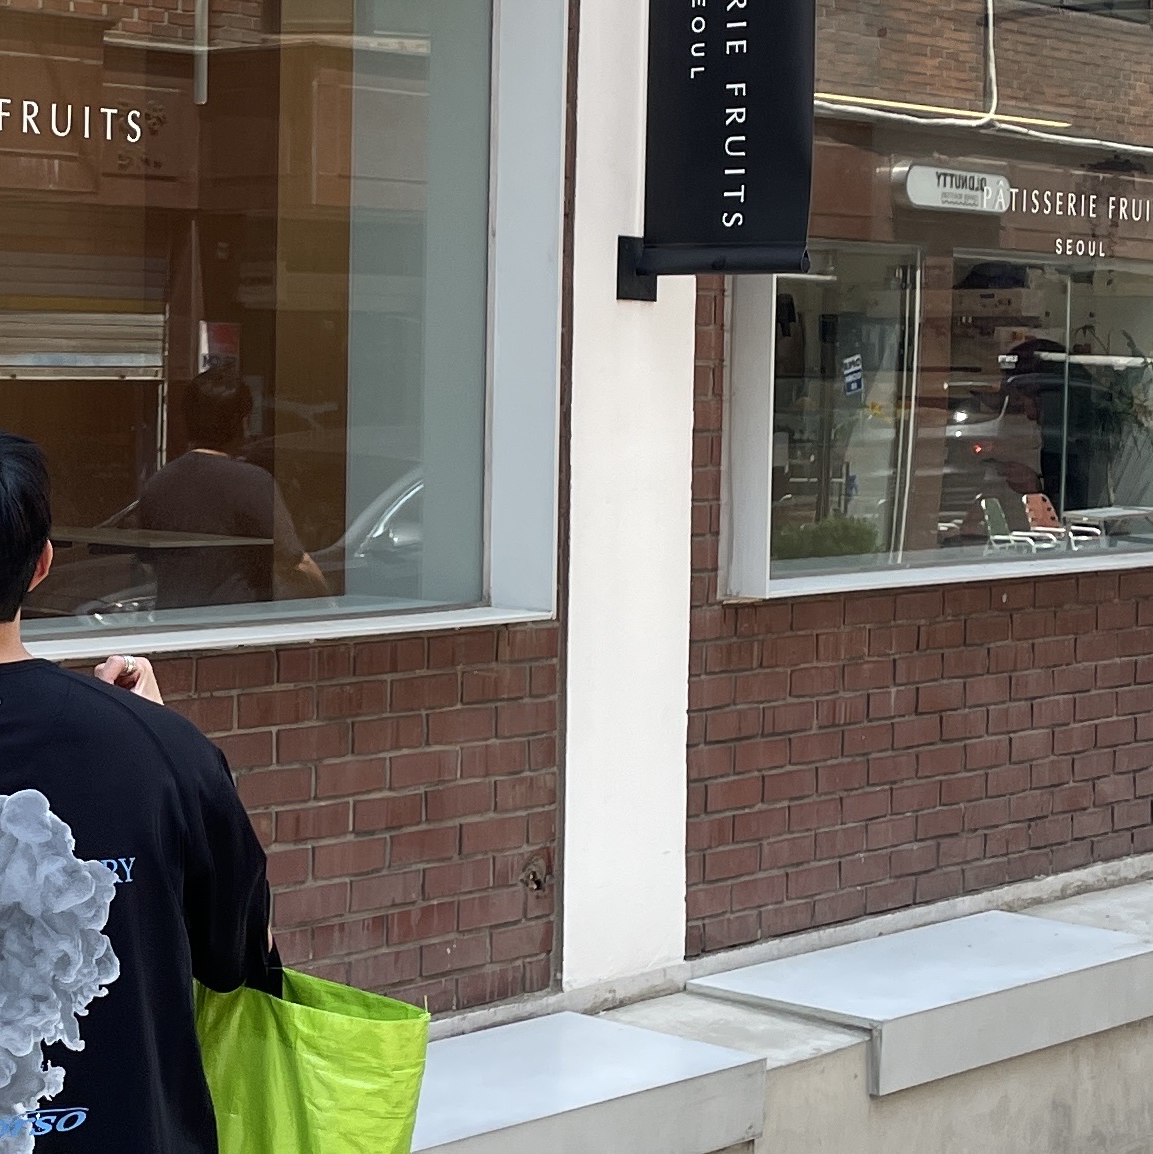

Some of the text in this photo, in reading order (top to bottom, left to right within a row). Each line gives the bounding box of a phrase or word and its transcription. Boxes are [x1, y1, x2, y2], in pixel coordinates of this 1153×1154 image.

[721, 82, 747, 228] FRUITS
[983, 180, 1097, 218] PÂTISSERIE
[1108, 196, 1150, 222] FRUI
[1055, 238, 1106, 257] SEOUL
